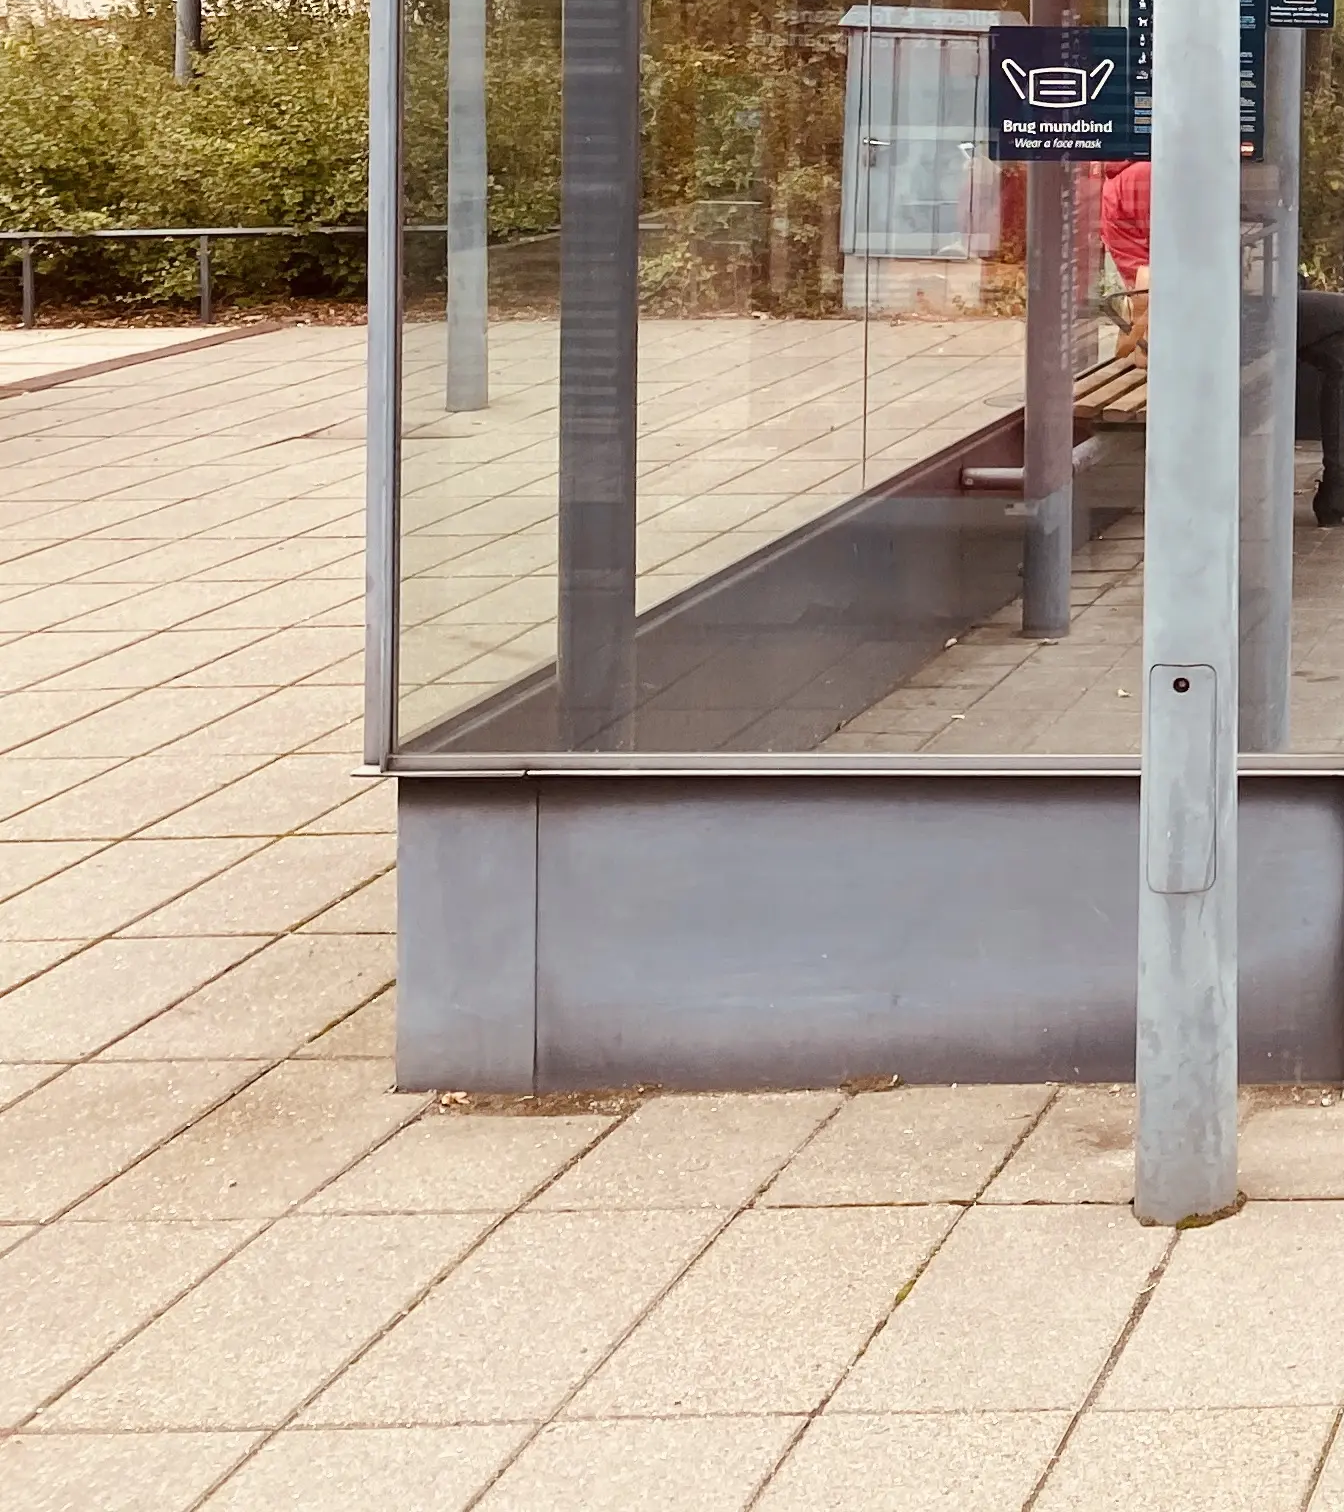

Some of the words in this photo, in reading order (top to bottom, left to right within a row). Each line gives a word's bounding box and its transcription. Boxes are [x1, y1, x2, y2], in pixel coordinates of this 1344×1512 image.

[1003, 119, 1037, 135] Brug
[1040, 119, 1113, 133] mundbind
[1014, 137, 1042, 148] Wear
[1043, 140, 1051, 148] a
[1052, 137, 1074, 148] face
[1074, 138, 1102, 149] mask
